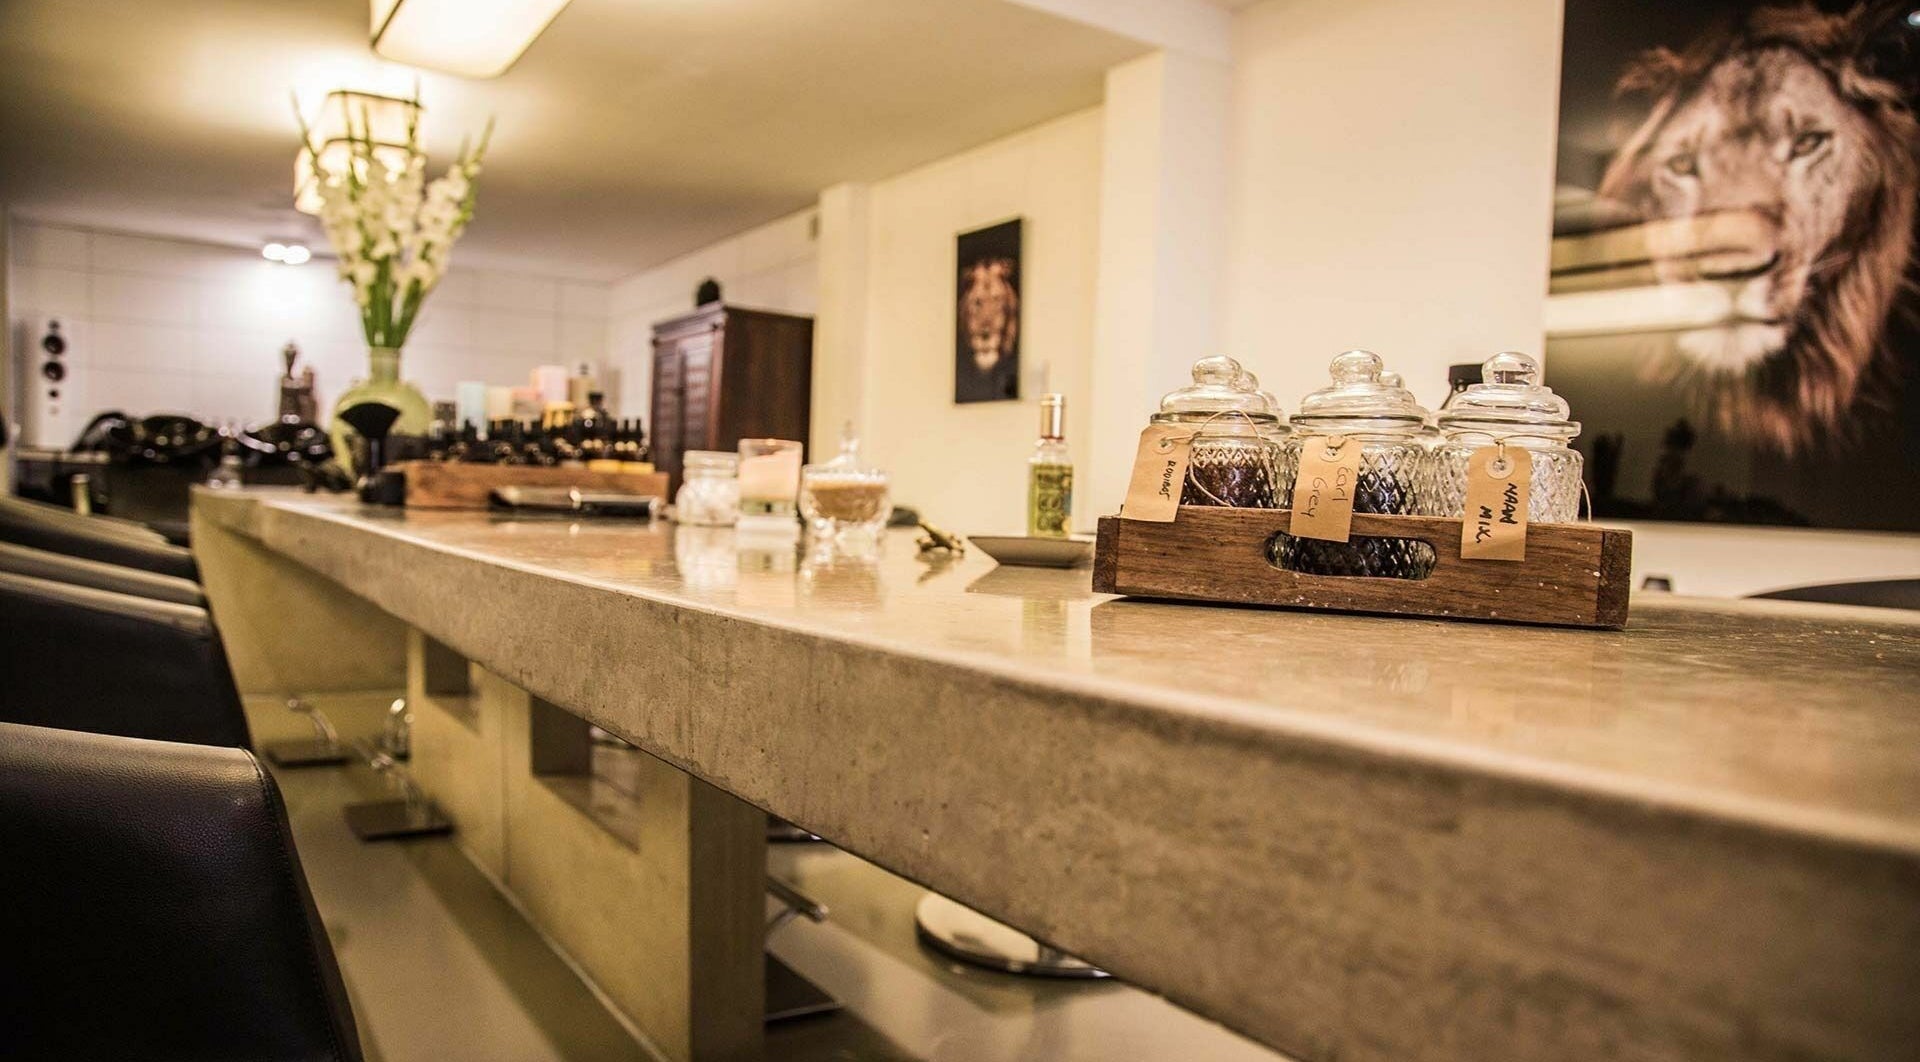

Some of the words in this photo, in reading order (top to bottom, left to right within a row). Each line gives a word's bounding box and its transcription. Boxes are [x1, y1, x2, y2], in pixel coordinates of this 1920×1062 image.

[1159, 460, 1176, 501] ROOIBOS
[1300, 477, 1329, 518] Grey
[1332, 467, 1355, 501] Earl
